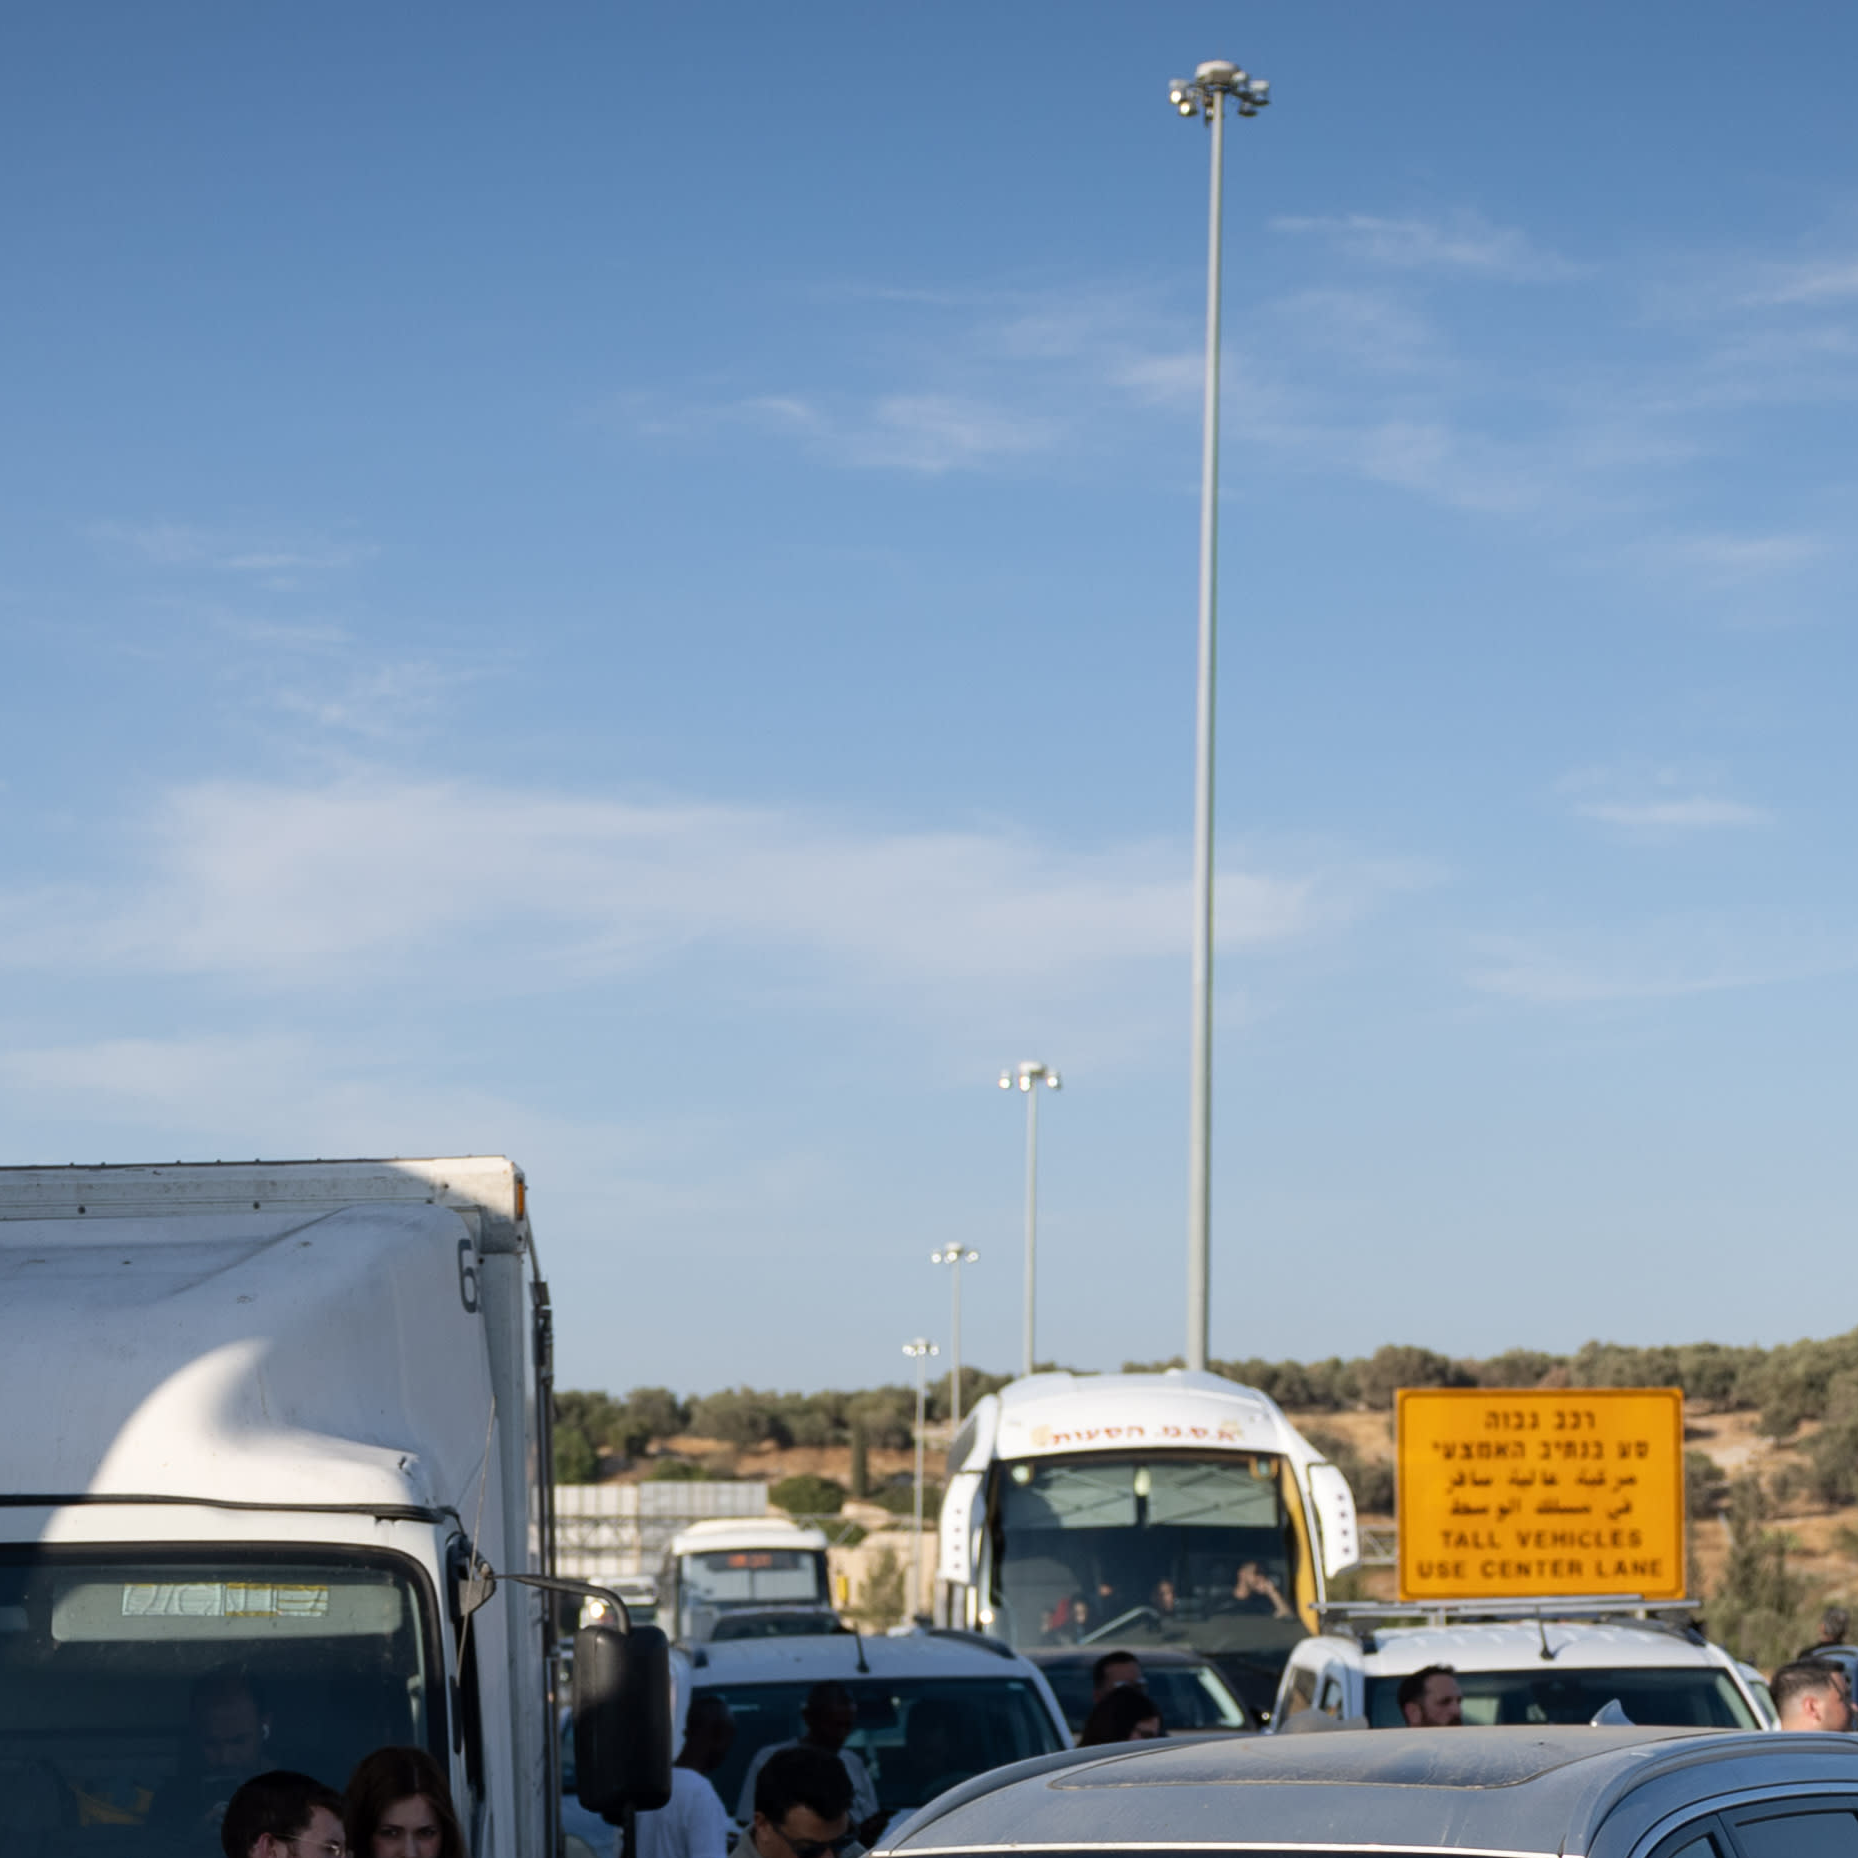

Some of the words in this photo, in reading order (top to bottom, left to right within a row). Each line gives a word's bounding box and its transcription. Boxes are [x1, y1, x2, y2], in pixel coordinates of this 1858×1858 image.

[1484, 1409, 1540, 1432] גבוה
[1553, 1409, 1596, 1431] רכב
[1431, 1440, 1526, 1461] האמצעי
[1538, 1440, 1604, 1461] בנתיב
[1617, 1440, 1650, 1460] סע
[1440, 1530, 1502, 1550] TALL
[1516, 1528, 1644, 1550] VEHICLES
[1416, 1560, 1466, 1580] USE
[1480, 1559, 1584, 1580] CENTER
[1595, 1558, 1664, 1578] LANE
